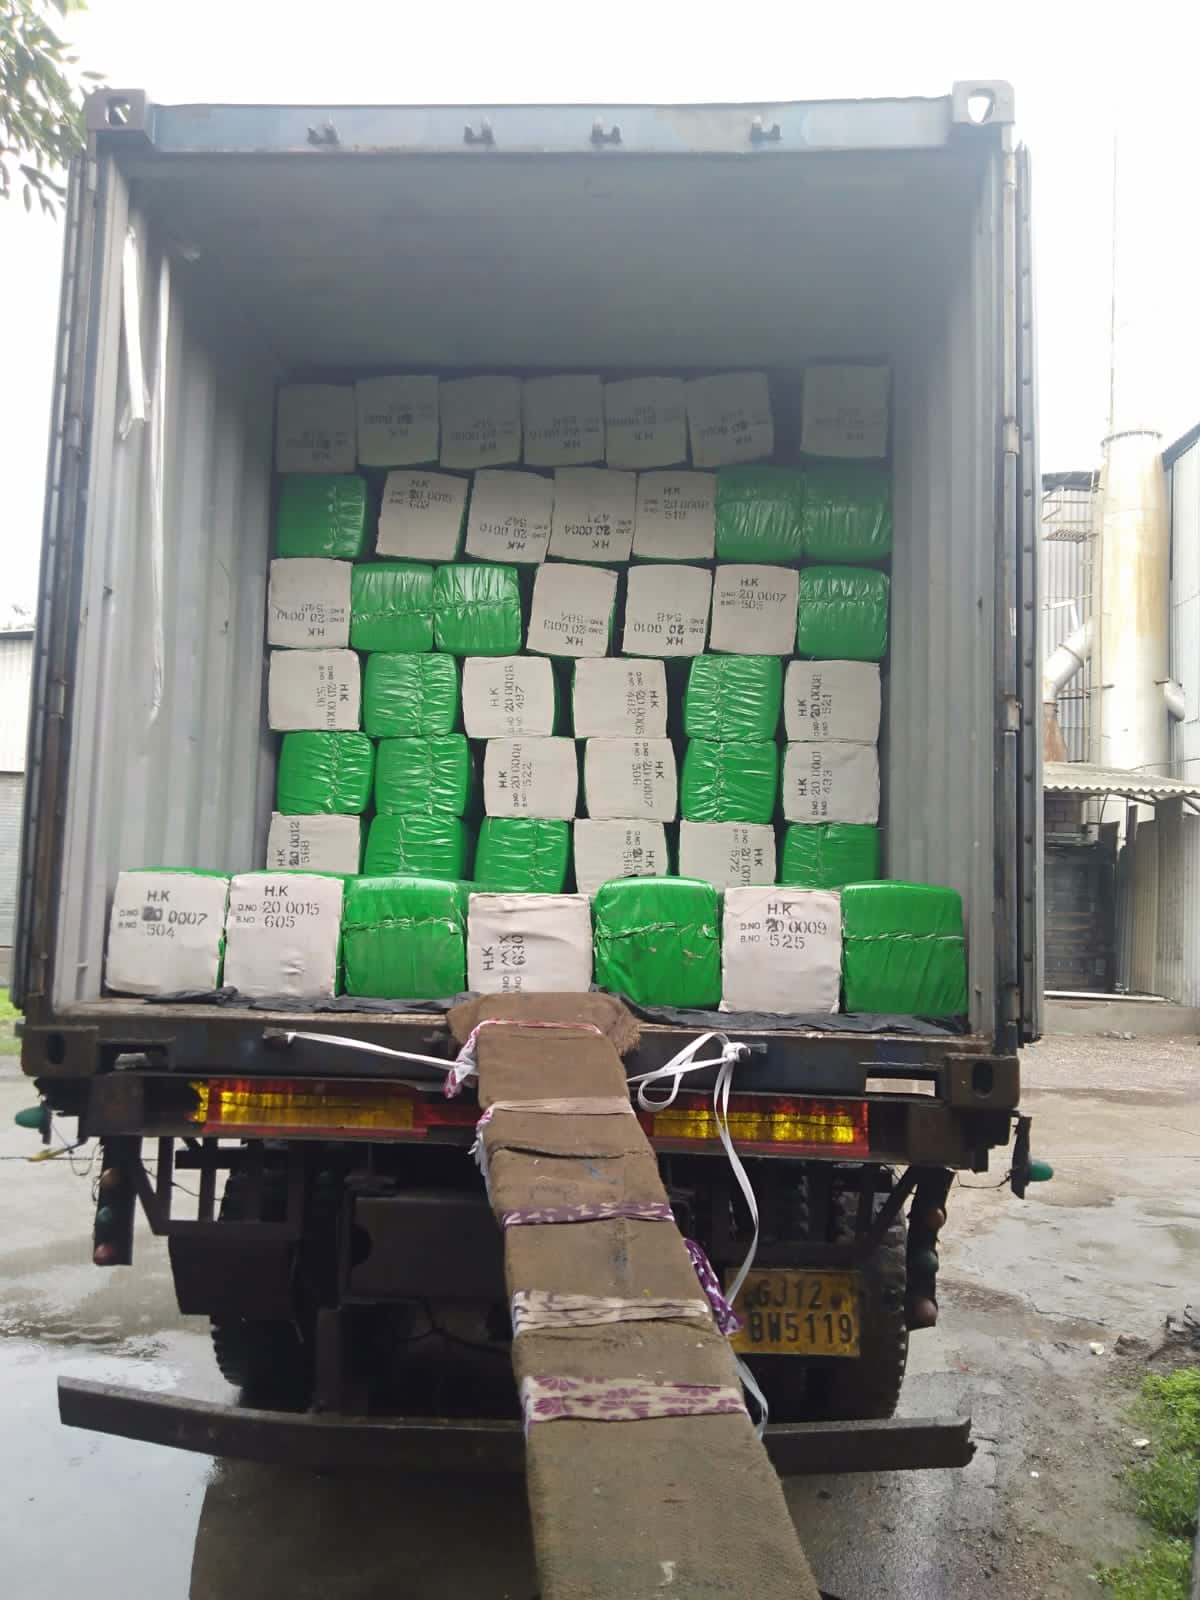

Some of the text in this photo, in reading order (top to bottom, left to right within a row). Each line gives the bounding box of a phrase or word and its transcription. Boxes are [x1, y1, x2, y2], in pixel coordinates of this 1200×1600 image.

[513, 528, 527, 538] 20
[669, 625, 684, 635] 20
[666, 636, 683, 646] H.K
[655, 761, 664, 779] H.K
[277, 849, 285, 866] H.K
[147, 889, 171, 902] H.K
[264, 885, 289, 897] H.K
[262, 901, 281, 915] 20
[285, 903, 320, 916] 0015
[767, 904, 792, 915] H.K
[168, 910, 208, 926] 0007
[264, 915, 296, 929] 605
[146, 924, 175, 938] 504
[788, 920, 827, 935] 0009
[769, 934, 805, 949] 525
[482, 946, 494, 971] H.K
[750, 1312, 853, 1344] BW5119
